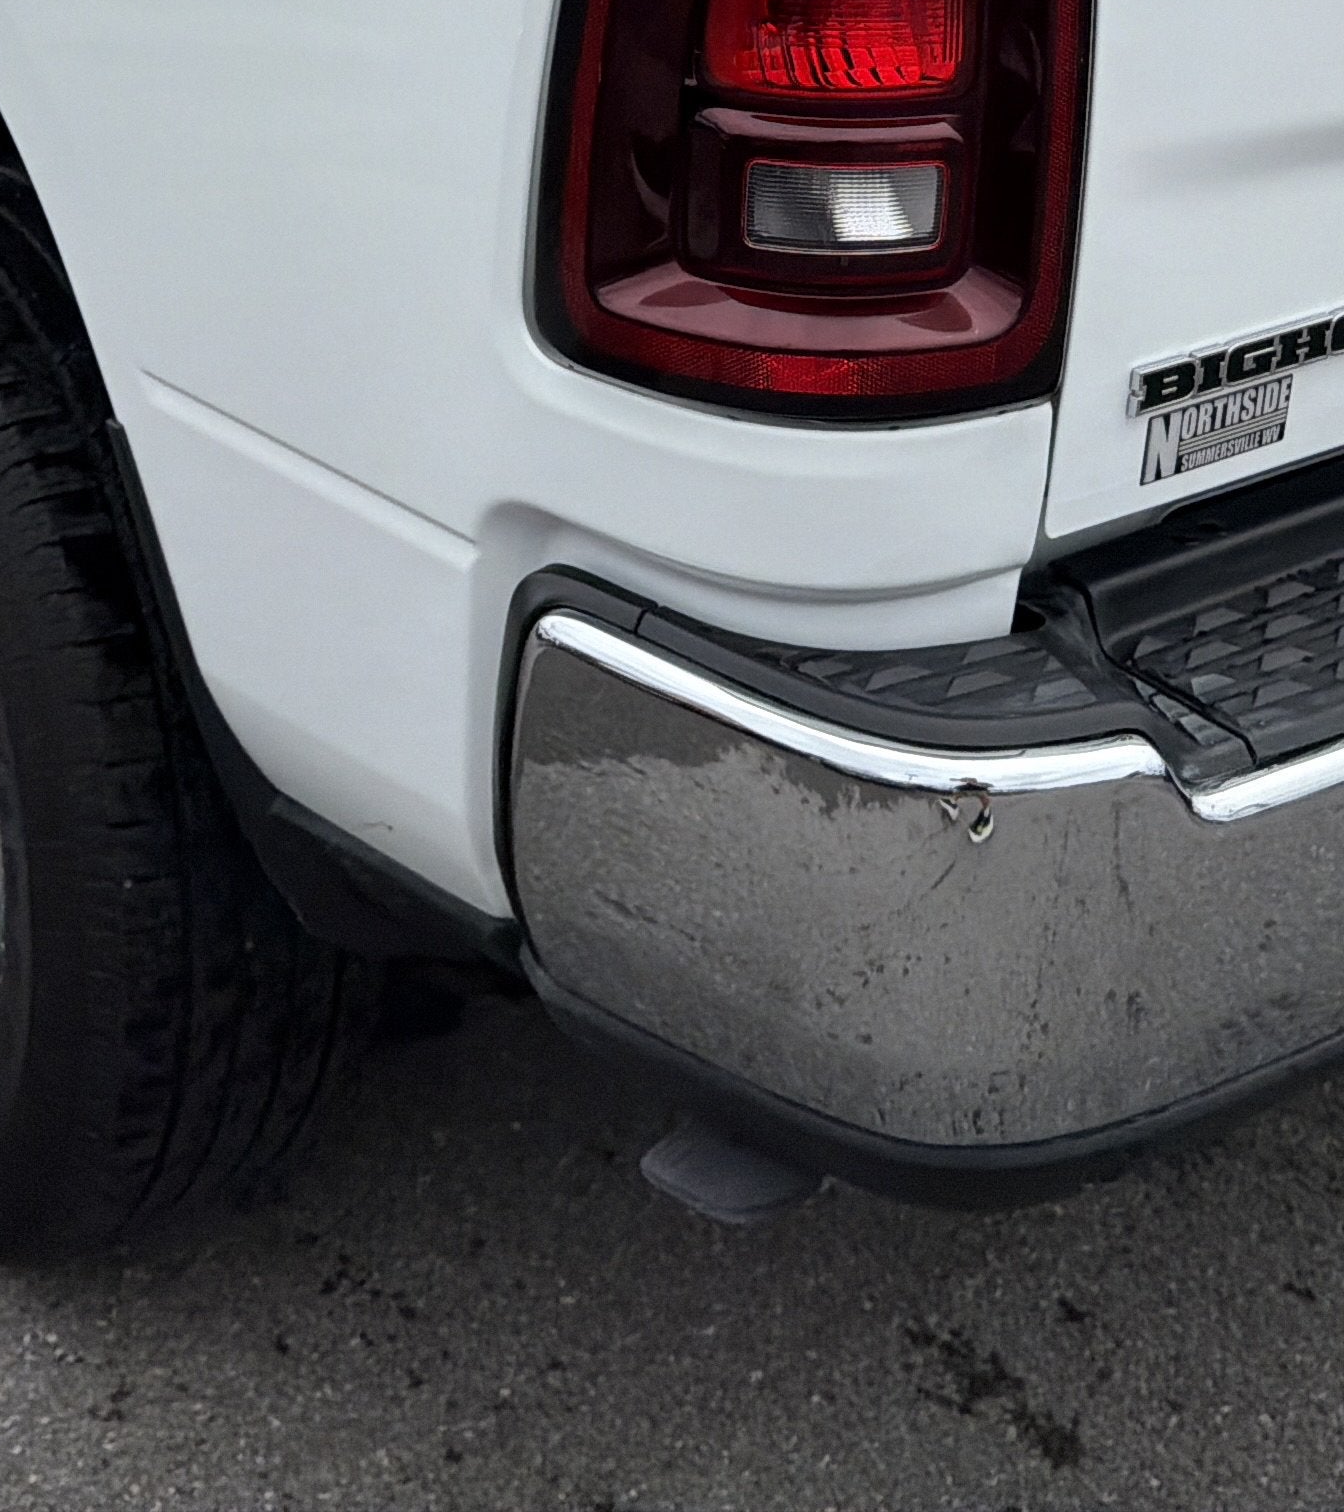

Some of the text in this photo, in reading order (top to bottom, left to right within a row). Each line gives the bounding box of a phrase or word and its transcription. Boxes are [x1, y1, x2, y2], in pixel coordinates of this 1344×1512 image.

[1142, 376, 1293, 483] NORTHSIDE
[1180, 425, 1281, 471] SUMMERSVILLE WV
